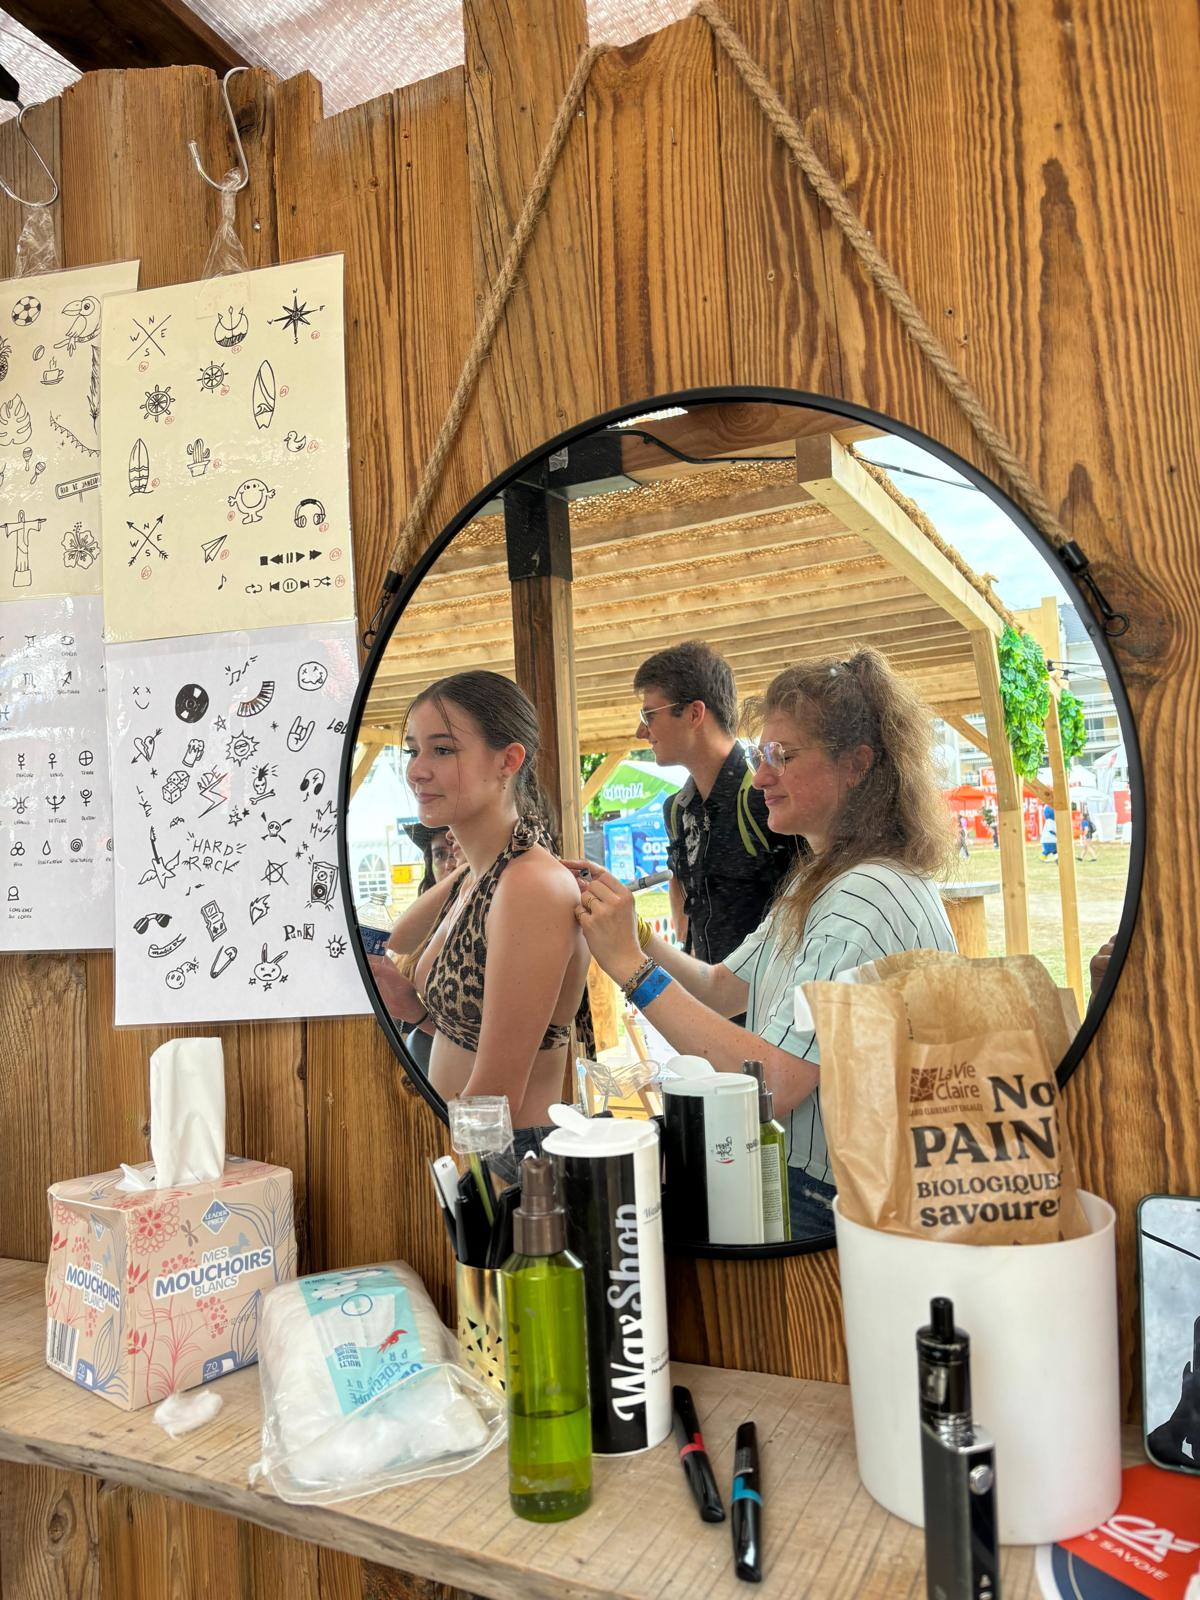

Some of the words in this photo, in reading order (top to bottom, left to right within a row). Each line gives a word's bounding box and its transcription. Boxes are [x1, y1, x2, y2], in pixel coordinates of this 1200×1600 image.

[148, 315, 155, 325] N
[130, 333, 140, 342] W
[161, 329, 167, 338] E
[144, 348, 150, 357] S
[143, 522, 150, 530] N
[130, 540, 139, 548] W
[197, 765, 221, 791] RIDE
[136, 785, 152, 818] LIKE
[193, 838, 234, 856] HARD
[188, 856, 240, 874] ROCK
[936, 1081, 980, 1100] Claire
[986, 1074, 1055, 1113] No
[910, 1117, 1058, 1168] PAIN
[920, 1199, 1061, 1228] savoure
[202, 1249, 228, 1264] MES
[155, 1249, 273, 1298] MOUCHOIRS
[66, 1265, 121, 1309] MOUCHOIRS
[194, 1277, 238, 1298] BLANCS
[206, 1361, 218, 1373] 70
[1100, 1540, 1168, 1581] SAVOIE
